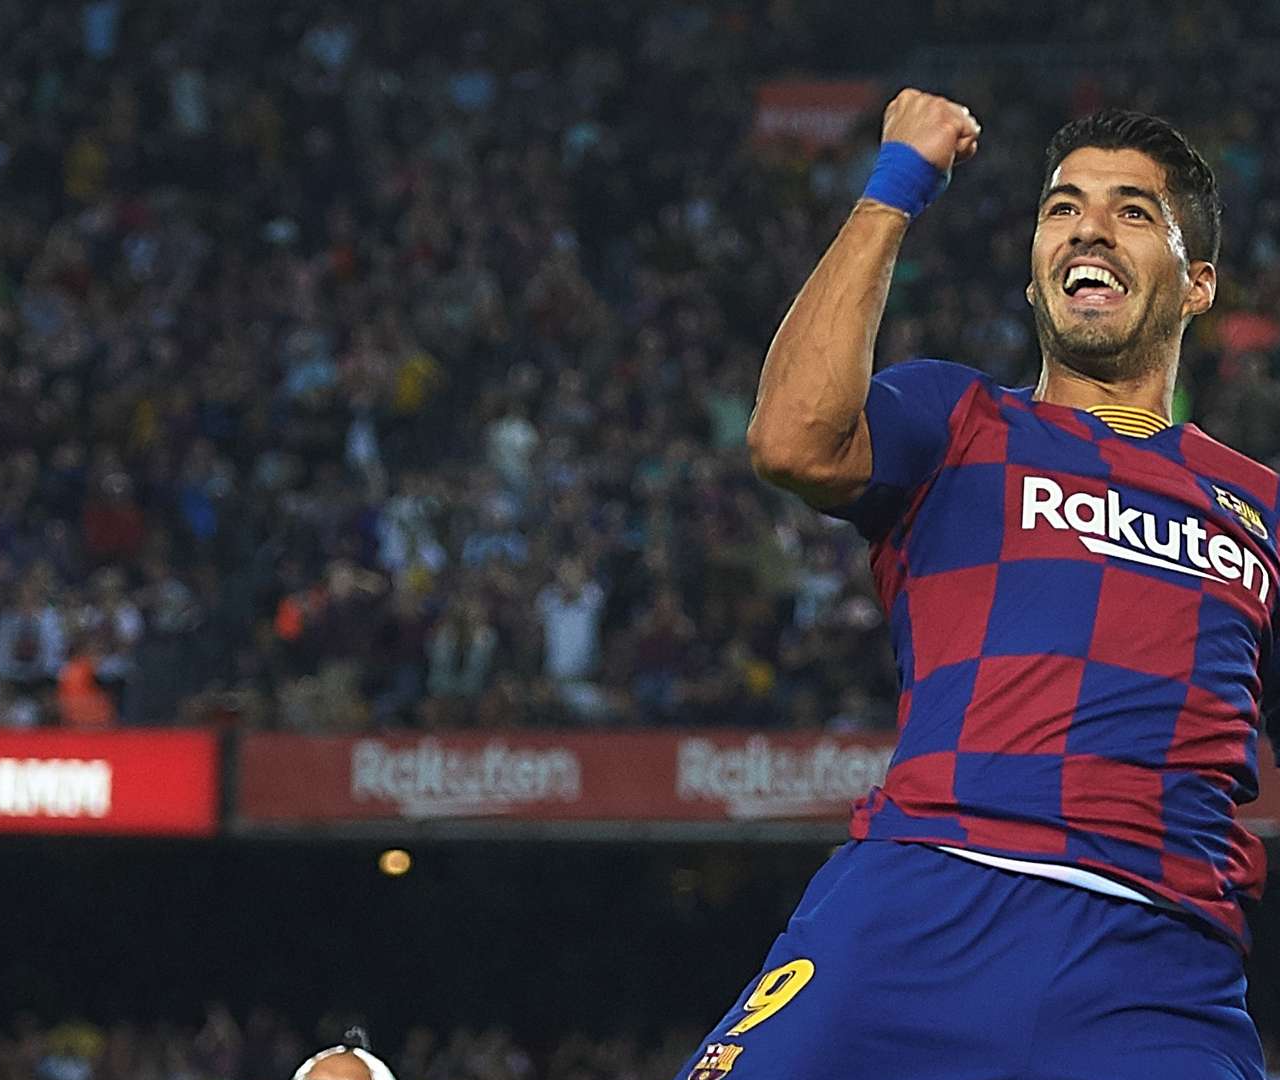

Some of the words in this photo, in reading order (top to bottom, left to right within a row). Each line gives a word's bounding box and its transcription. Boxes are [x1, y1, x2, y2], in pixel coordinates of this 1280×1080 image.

[1022, 476, 1270, 604] Rakuten
[351, 736, 581, 804] Rakuten
[725, 958, 816, 1037] 9
